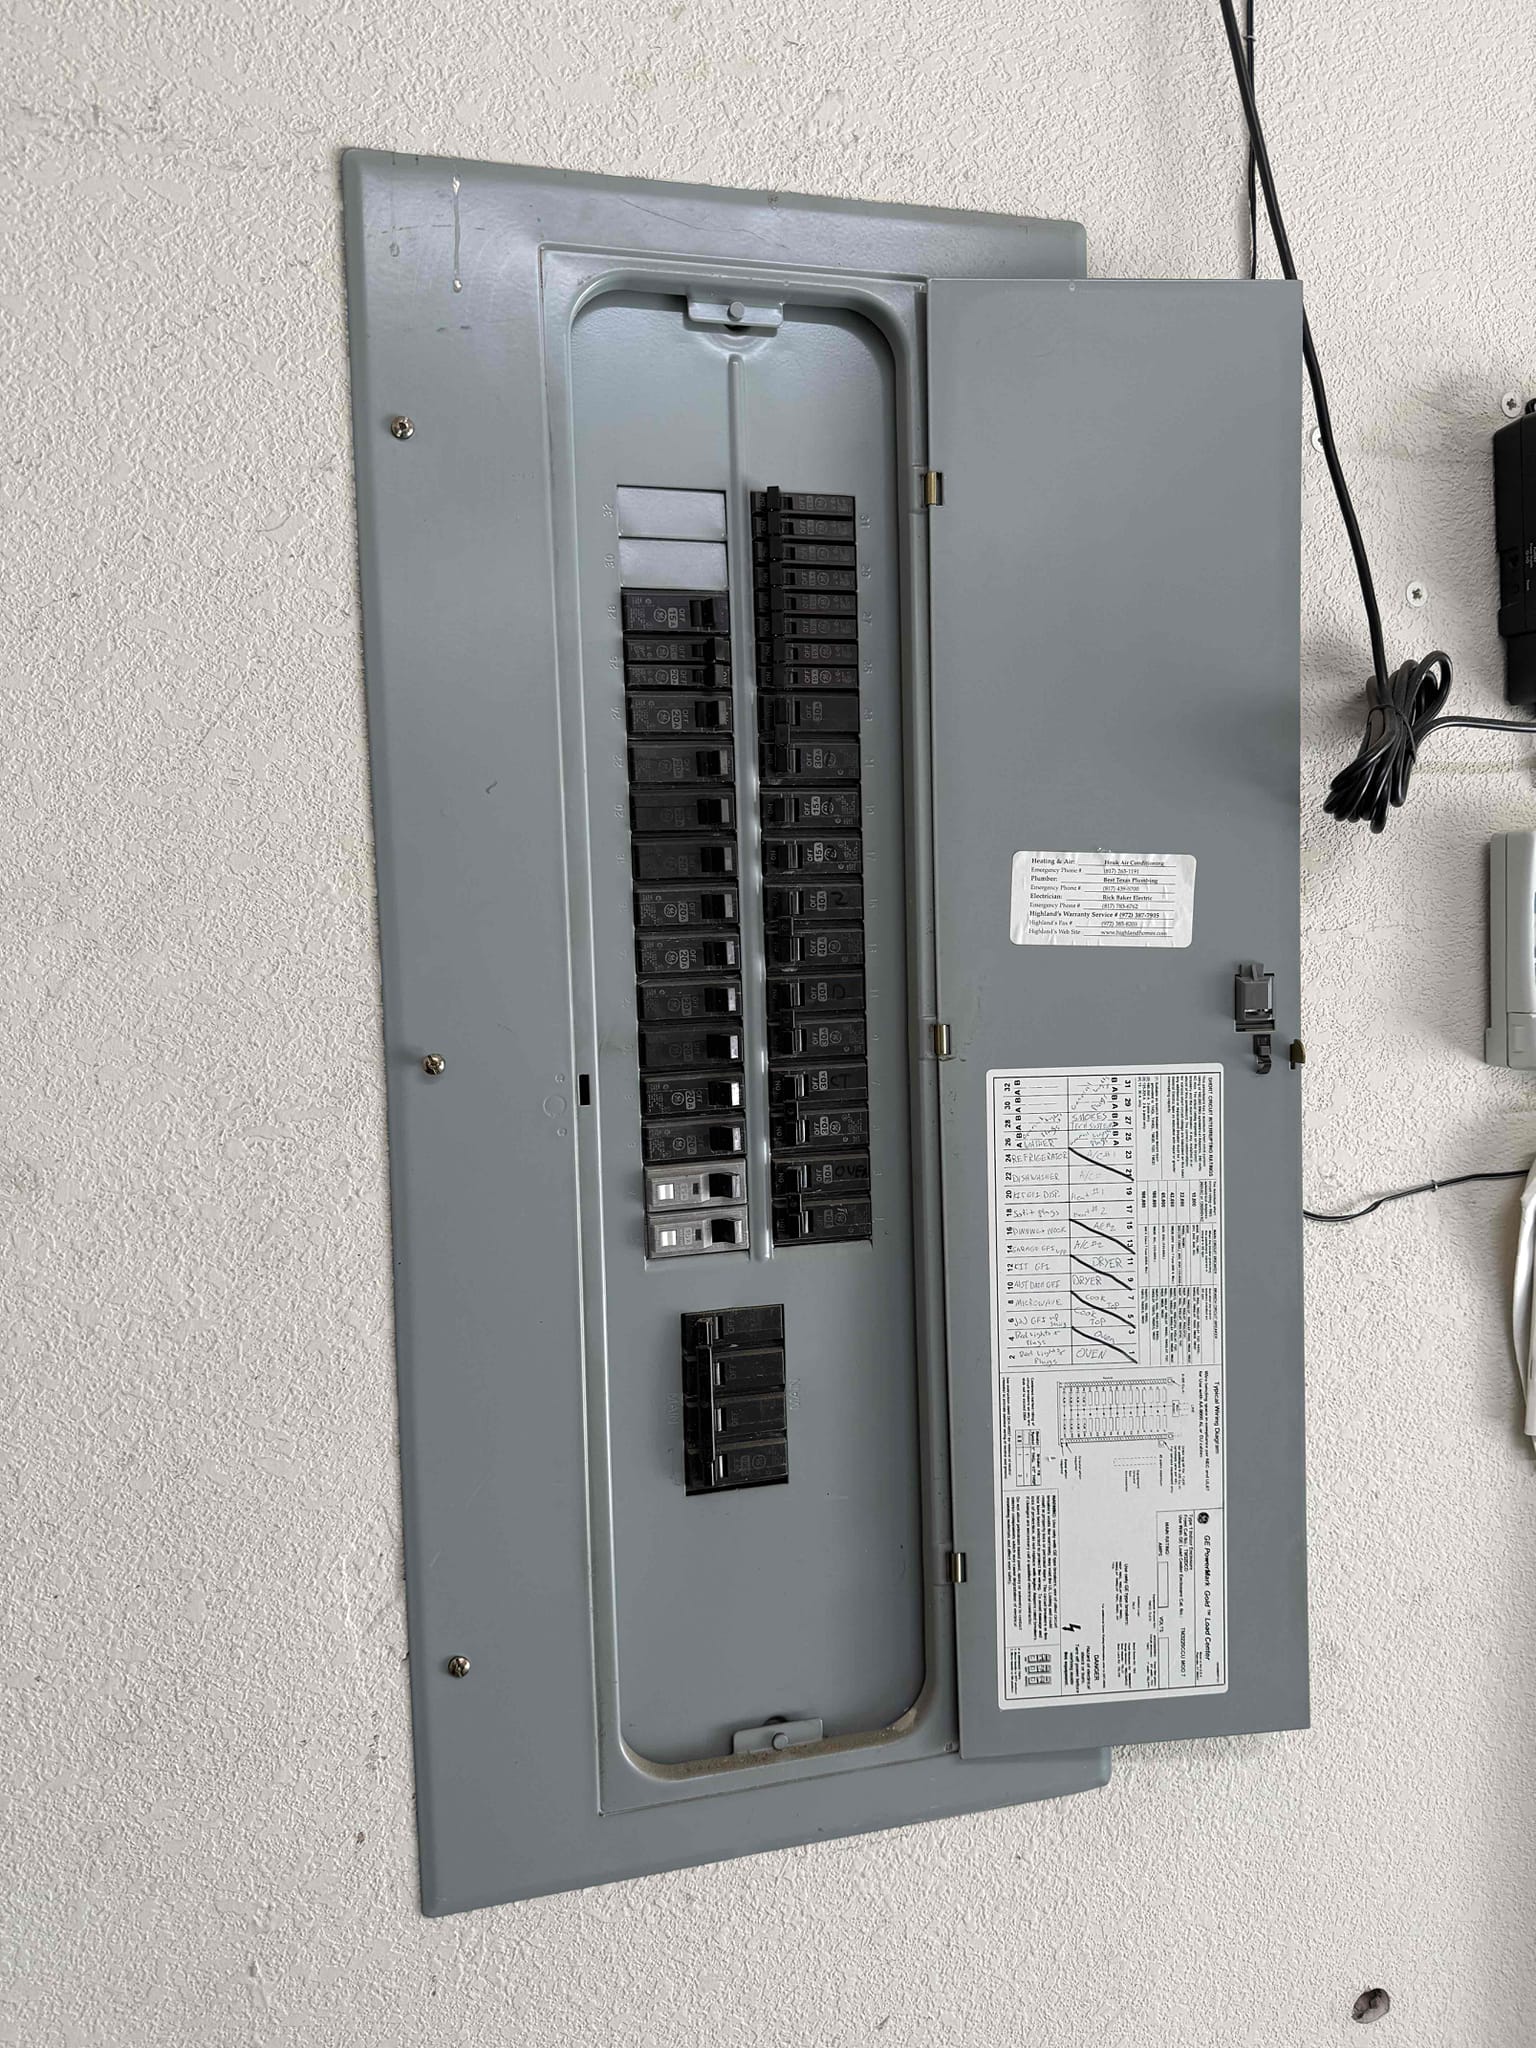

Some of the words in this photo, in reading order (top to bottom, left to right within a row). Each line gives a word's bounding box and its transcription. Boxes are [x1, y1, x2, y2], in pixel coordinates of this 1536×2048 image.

[668, 608, 677, 628] 15A
[670, 670, 678, 685] 20A
[814, 701, 822, 721] 30A
[672, 709, 681, 729] 20A
[814, 749, 823, 768] 30A
[812, 796, 820, 815] 15A
[814, 842, 823, 862] 15A
[817, 891, 827, 911] 40A
[678, 903, 688, 922] 20A
[817, 937, 827, 956] 40A
[679, 949, 689, 969] 20A
[818, 983, 827, 1001] 30A
[682, 997, 691, 1016] 20A
[819, 1027, 828, 1047] 30A
[683, 1044, 693, 1061] 20A
[819, 1071, 827, 1090] 30A
[1125, 1080, 1131, 1088] 31
[1004, 1083, 1010, 1092] 32
[685, 1090, 695, 1110] 20A
[1004, 1101, 1011, 1109] 30
[1125, 1098, 1131, 1107] 29
[820, 1116, 829, 1136] 30A
[1005, 1120, 1011, 1128] 28
[1125, 1116, 1131, 1125] 27
[1005, 1138, 1011, 1146] 26
[1125, 1132, 1132, 1141] 25
[687, 1136, 696, 1154] 20A
[1005, 1154, 1012, 1163] 24
[1012, 1151, 1067, 1163] REFRIGERATOR
[1125, 1151, 1132, 1159] 23
[823, 1165, 832, 1183] 30A
[1005, 1172, 1012, 1180] 22
[1013, 1174, 1059, 1183] DISHWASHER
[1006, 1190, 1012, 1199] 20
[1126, 1187, 1132, 1195] 19
[1006, 1208, 1012, 1216] 18
[1126, 1205, 1132, 1213] 17
[824, 1209, 833, 1228] 30A
[1006, 1227, 1013, 1235] 16
[1007, 1245, 1013, 1253] 14
[1074, 1239, 1089, 1249] A/C
[1007, 1264, 1013, 1272] 12
[1092, 1256, 1122, 1269] DRYER
[1008, 1282, 1014, 1290] 10
[1073, 1275, 1102, 1286] DRYER
[1015, 1298, 1063, 1307] MICROWAVE
[1076, 1348, 1106, 1359] OVEN
[1204, 1535, 1211, 1546] GE
